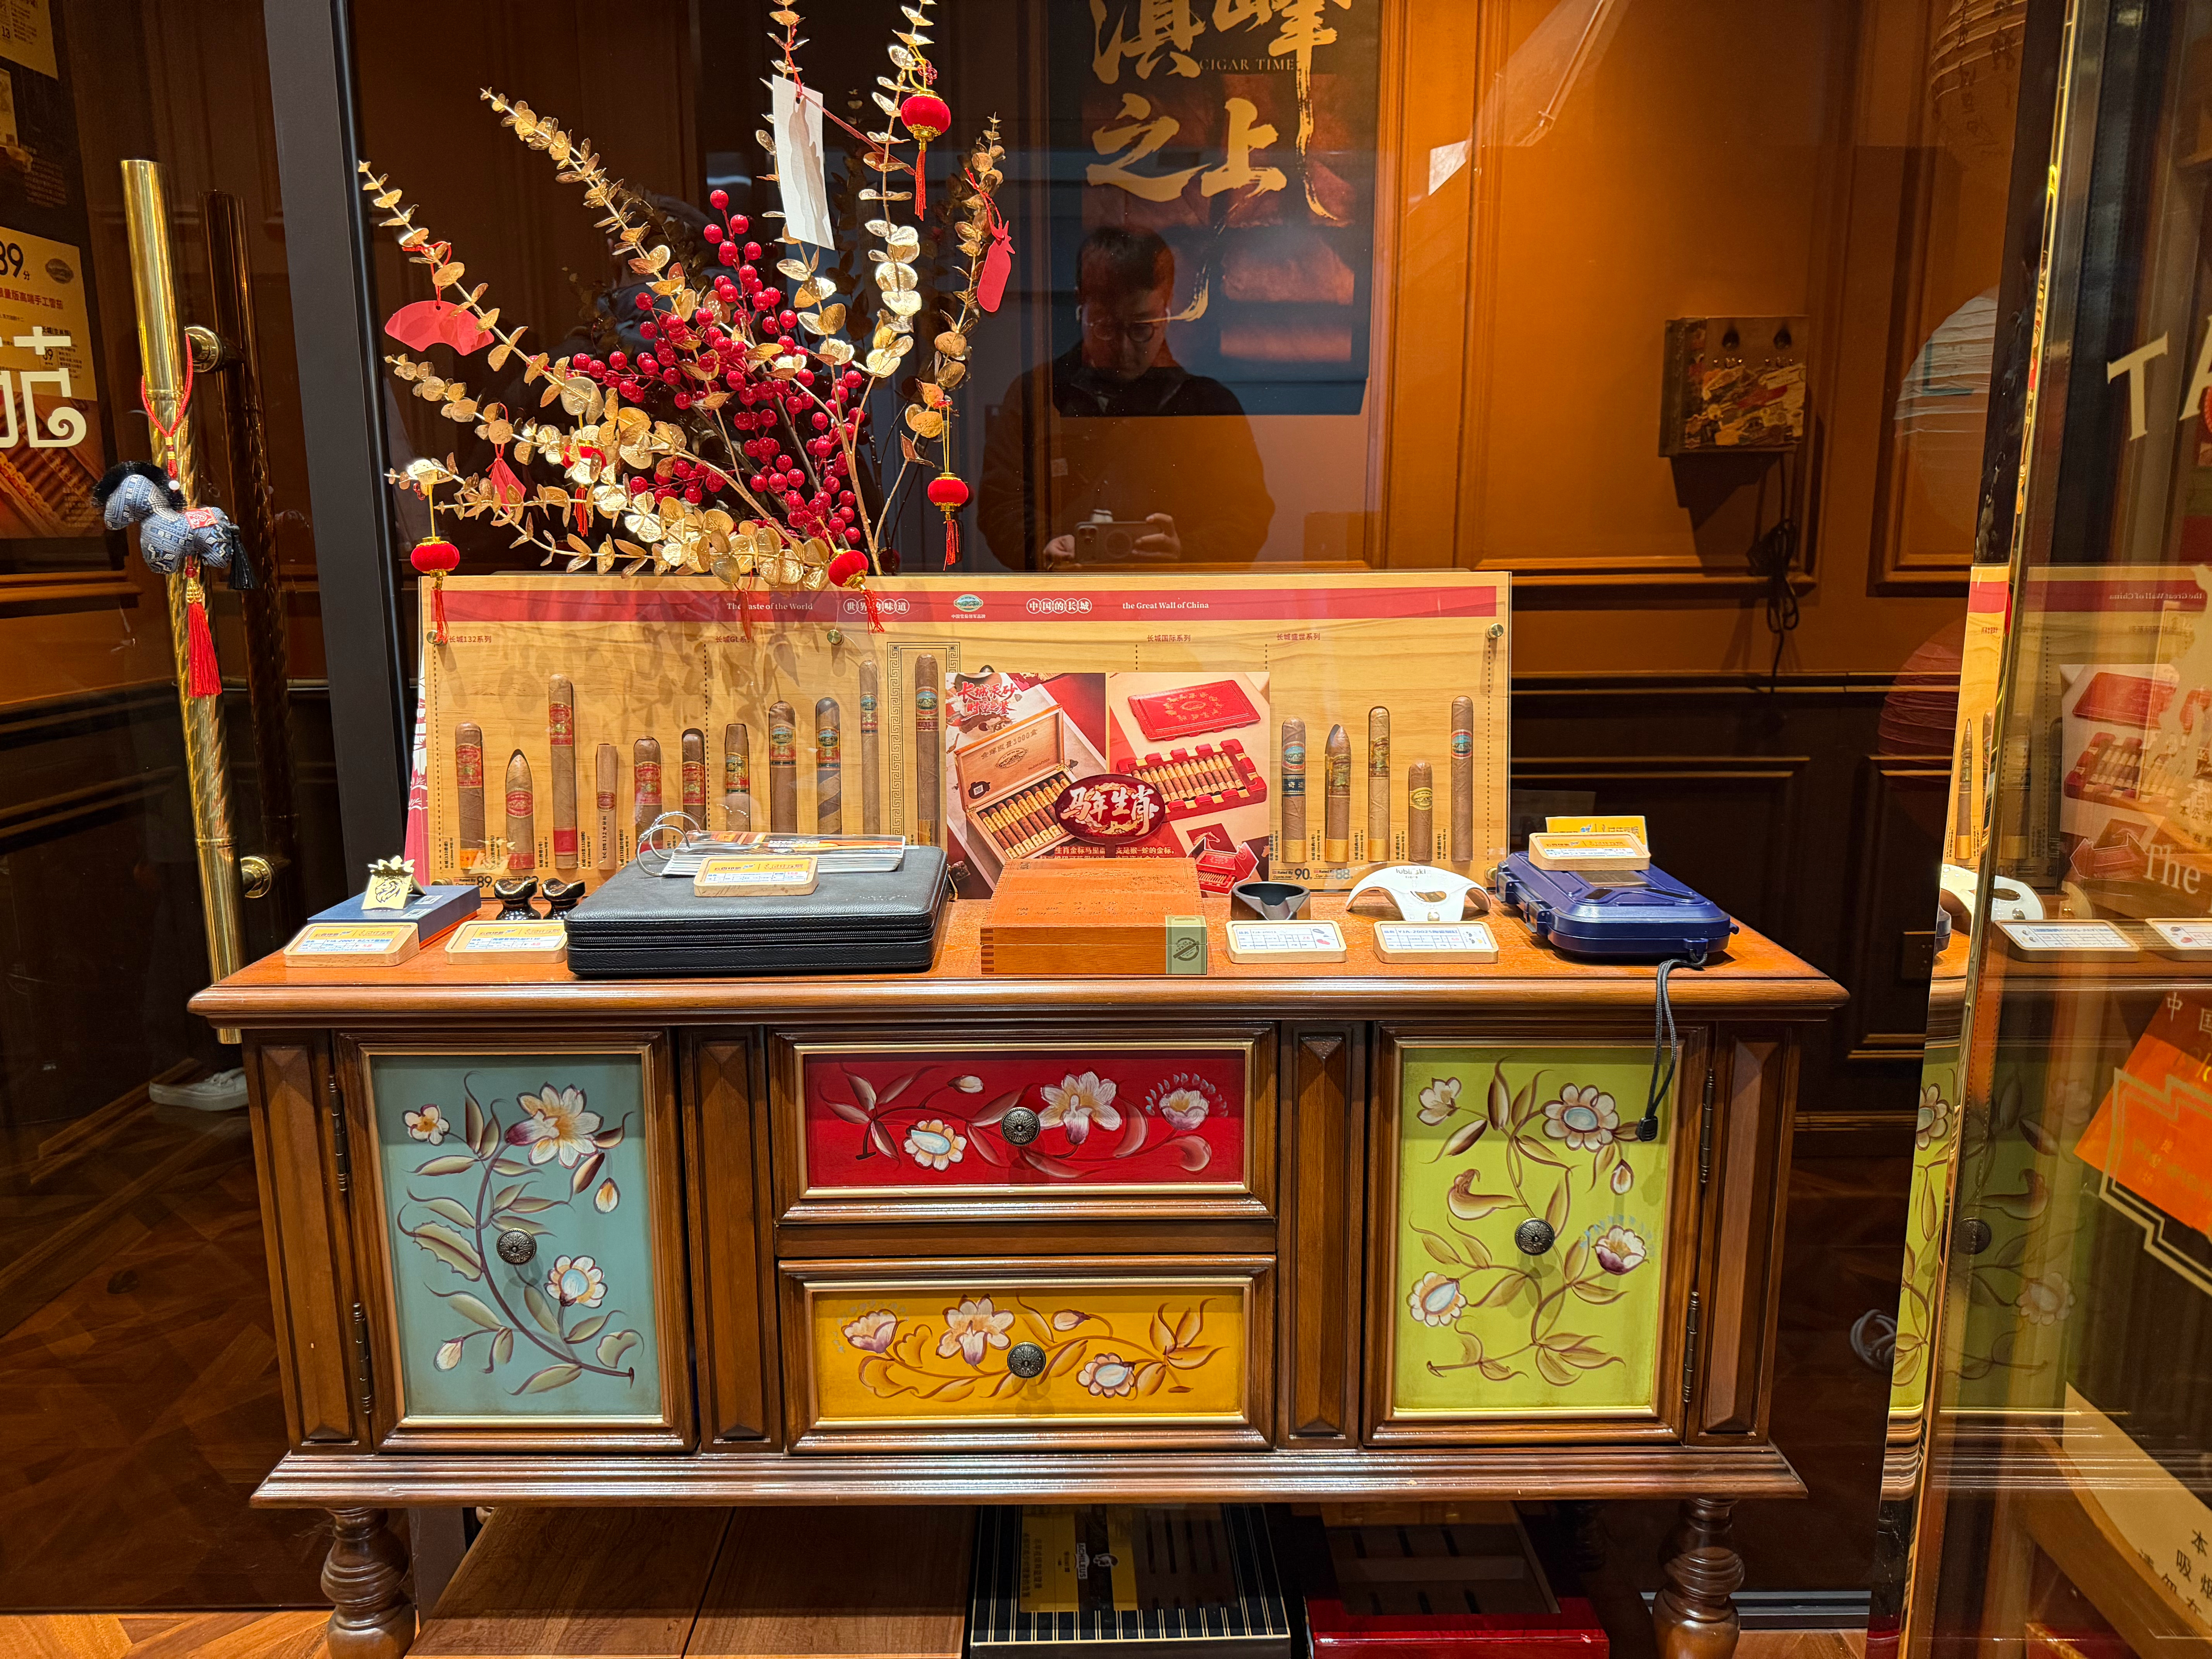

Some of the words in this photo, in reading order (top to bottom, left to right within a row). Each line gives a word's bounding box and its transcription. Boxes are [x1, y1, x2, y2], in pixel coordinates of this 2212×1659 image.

[1199, 58, 1249, 71] CIGAR
[1086, 93, 1288, 202] 之上
[789, 602, 813, 610] World
[1029, 601, 1090, 611] 中国的长城
[1186, 601, 1209, 609] China
[449, 635, 492, 643] 长城132系列
[1276, 633, 1321, 641] 长城盛世系列
[1295, 868, 1310, 880] 90
[477, 875, 493, 888] 89
